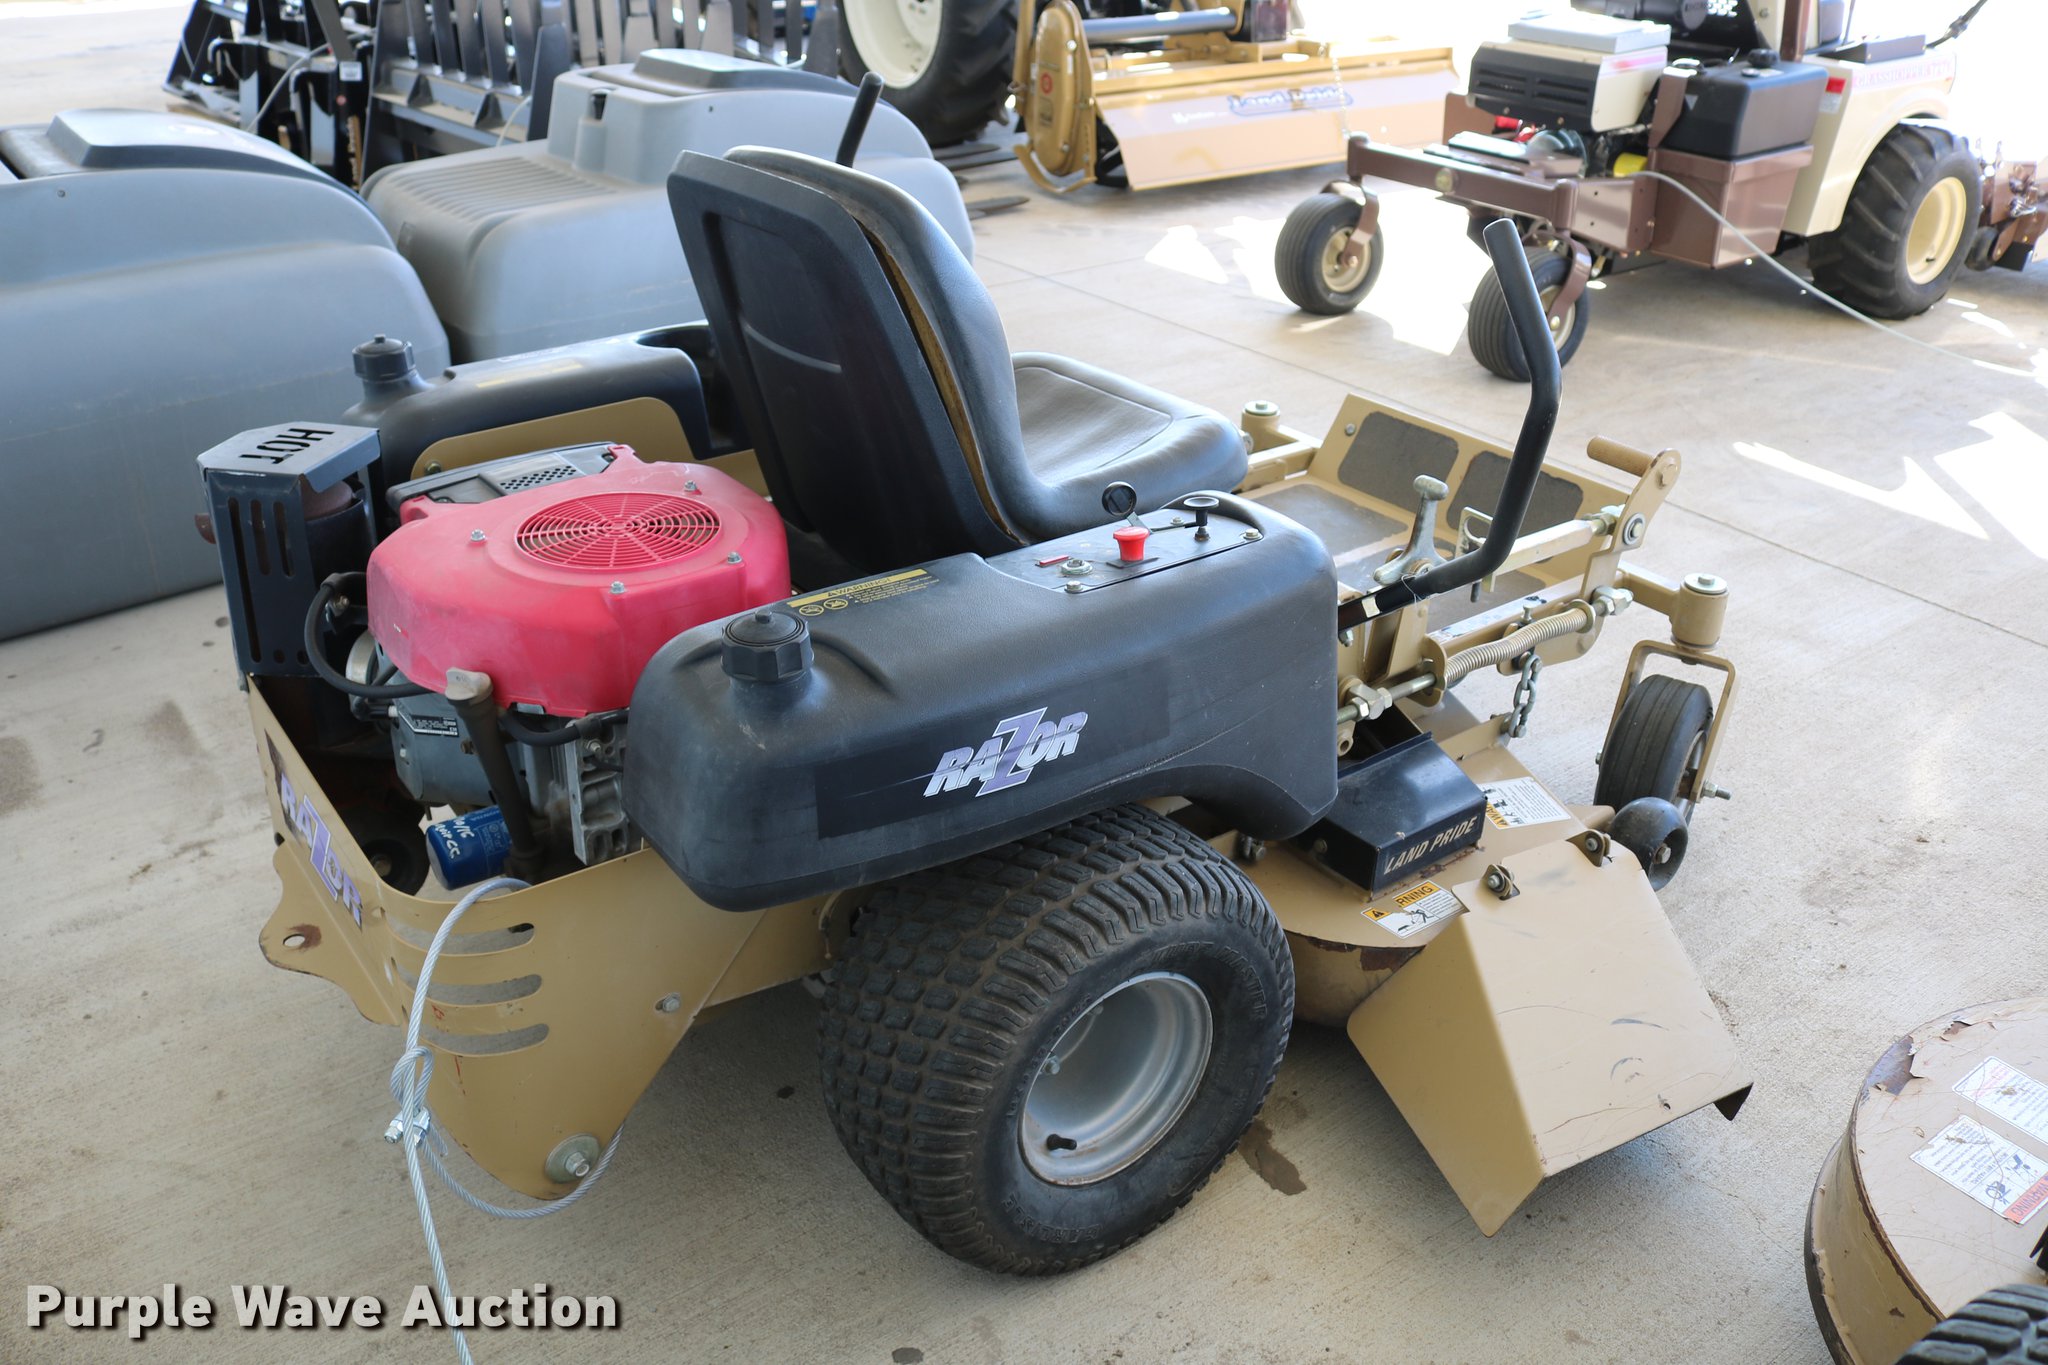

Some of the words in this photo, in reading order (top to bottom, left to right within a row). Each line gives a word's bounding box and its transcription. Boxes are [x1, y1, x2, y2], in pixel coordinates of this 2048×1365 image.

[239, 428, 335, 465] HOT
[923, 707, 1089, 797] RAZOR
[281, 771, 363, 931] RAZOR
[1383, 844, 1427, 875] LAND
[1430, 816, 1477, 851] PRIDE
